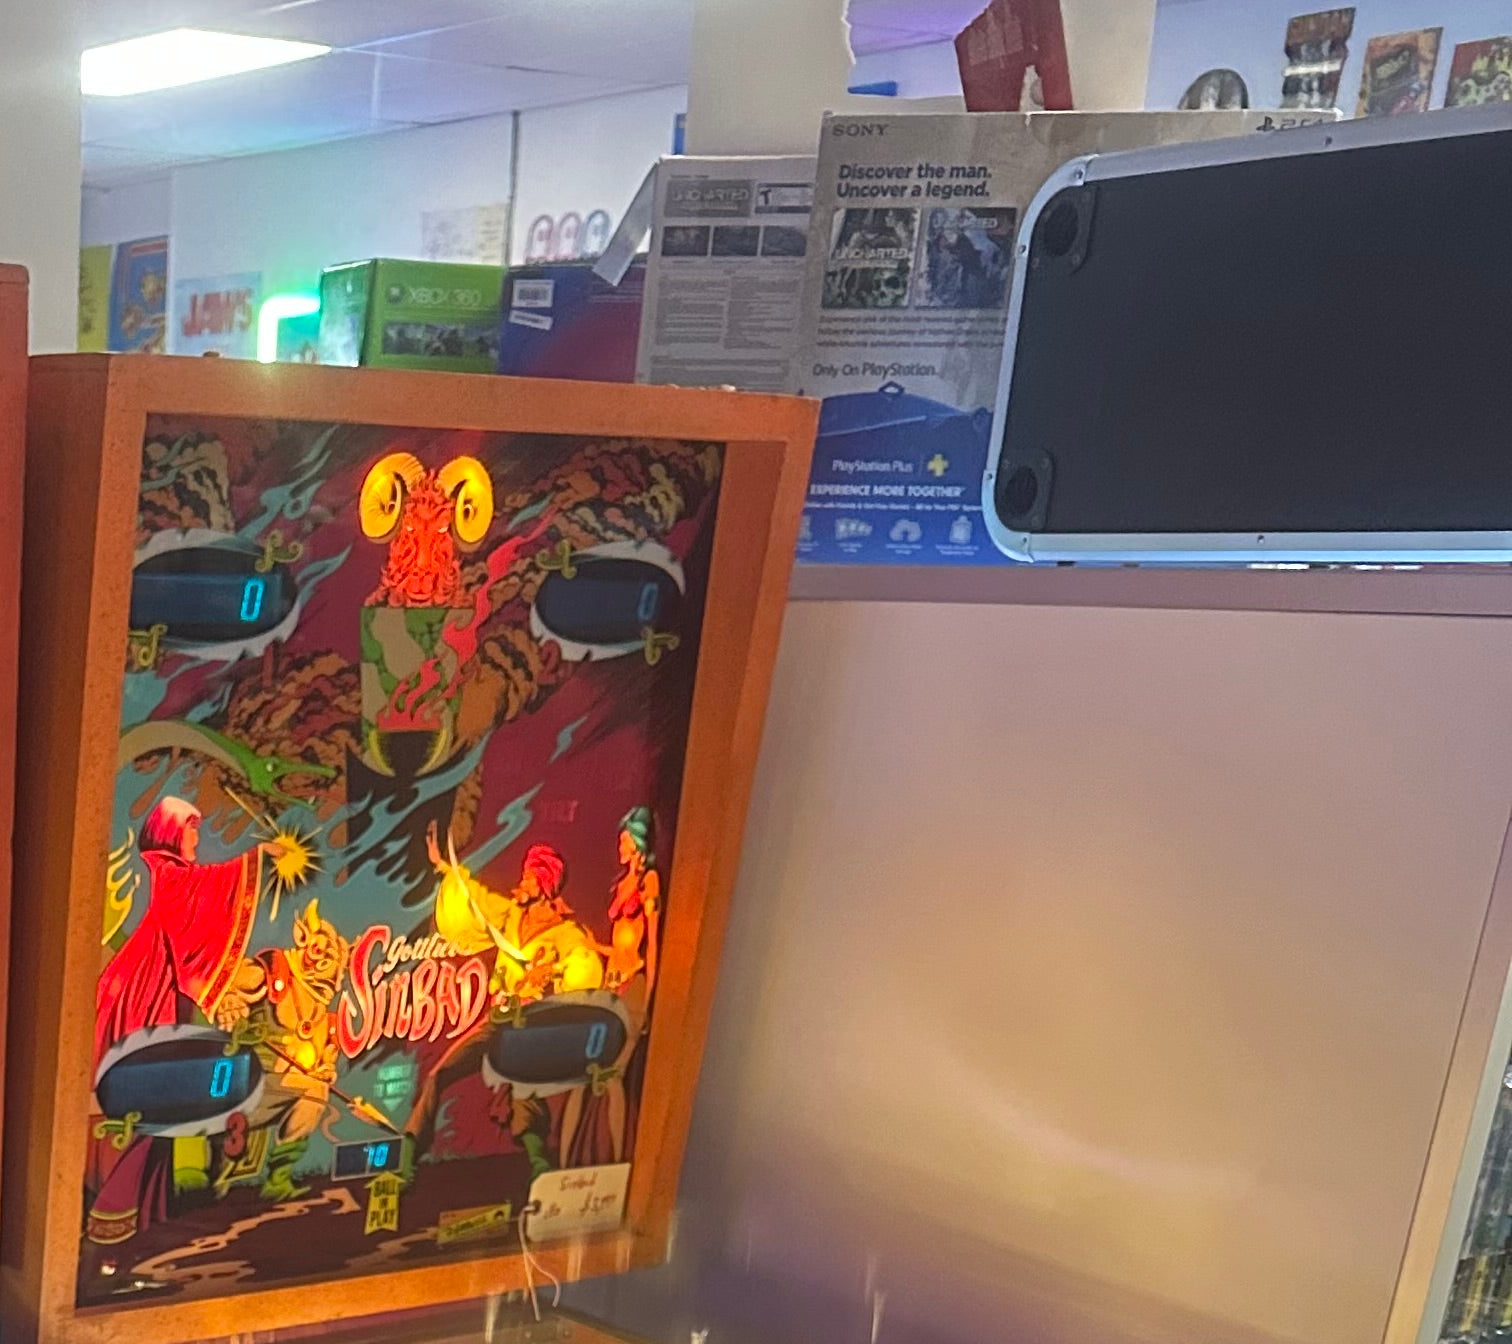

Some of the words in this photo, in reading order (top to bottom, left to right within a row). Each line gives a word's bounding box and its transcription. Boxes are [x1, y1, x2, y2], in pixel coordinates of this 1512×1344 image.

[832, 123, 888, 137] SONY
[839, 164, 912, 180] Discover
[917, 163, 945, 179] the
[949, 166, 992, 179] man.
[837, 182, 906, 198] Uncover
[911, 185, 921, 197] a
[926, 181, 990, 199] legend.
[181, 287, 254, 338] JAWS
[813, 363, 839, 378] Only
[842, 364, 859, 375] On
[832, 458, 890, 474] PlayStation
[892, 460, 914, 473] Plus
[810, 484, 871, 497] EXPERIENCE
[873, 485, 906, 497] MORE
[240, 576, 265, 622] 0
[637, 580, 660, 622] 0
[208, 1057, 235, 1100] 0
[223, 1110, 247, 1159] 3
